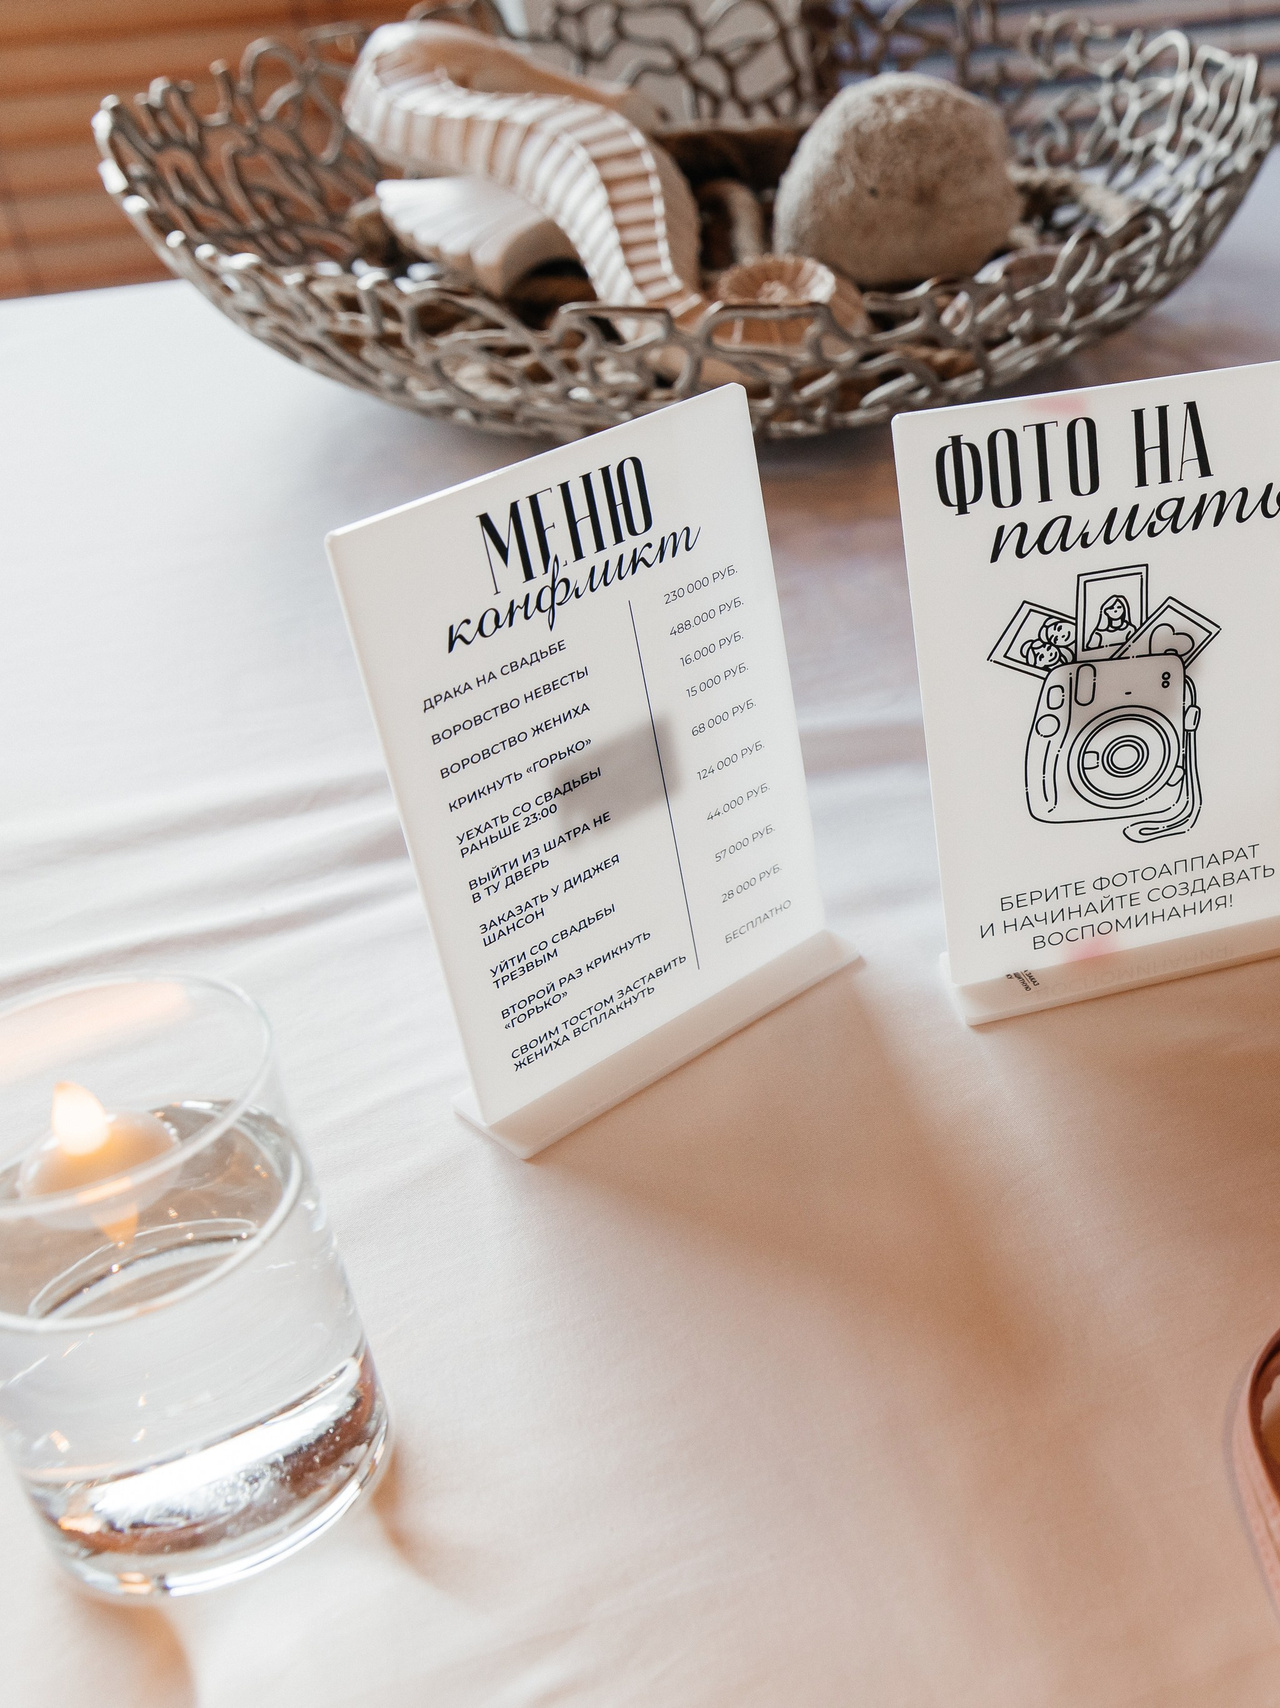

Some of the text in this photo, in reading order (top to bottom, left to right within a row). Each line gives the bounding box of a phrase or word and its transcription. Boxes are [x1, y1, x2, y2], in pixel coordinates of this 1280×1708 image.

[935, 400, 1214, 516] ФОТО НА
[476, 456, 653, 595] МЕНЮ
[447, 525, 702, 654] конфликт
[664, 564, 738, 605] 230 000 РУБ.
[669, 597, 744, 636] 488.000 РУБ.
[423, 640, 566, 713] ДРАКА НА СВАДЬБЕ
[680, 631, 744, 667] 16.000 РУБ.
[686, 662, 748, 697] 15 000 РУБ.
[431, 666, 589, 745] ВОРОВСТВО НЕВЕСТЫ
[691, 698, 756, 737] 68 000 РУБ.
[440, 703, 590, 779] ВОРОВСТВО ЖЕНИХА
[697, 740, 765, 780] 124 000 РУБ.
[449, 738, 591, 812] КРИКНУТЬ «ГОРЬКО»
[456, 767, 601, 845] УЕХАТЬ СО СВАДЬБЫ
[706, 782, 770, 821] 44.000 РУБ.
[460, 804, 557, 858] РАНЬШЕ 23:00
[468, 811, 611, 890] ВЫЙТИ ИЗ ШАТРА НЕ
[715, 824, 775, 862] 57 000 РУБ.
[472, 858, 550, 903] В ТУ ДВЕРЬ
[479, 854, 620, 935] ЗАКАЗАТЬ У ДИДЖЕЯ
[721, 864, 782, 903] 28 000 РУБ.
[980, 864, 1275, 938] И НАЧИНАЙТЕ СОЗДАВАТЬ
[1000, 843, 1260, 911] БЕРИТЕ ФОТОАППАРАТ
[483, 908, 544, 947] ШАНСОН
[490, 904, 616, 978] УЙТИ СО СВАДЬБЫ
[724, 900, 792, 944] БЕСПЛАТНО
[1033, 893, 1233, 950] ВОСПОМИНАНИЯ!
[493, 949, 558, 989] ТРЕЗВЫМ
[501, 931, 651, 1019] ВТОРОЙ РАЗ КРИКНУТЬ
[504, 991, 567, 1030] «ГОРЬКО»
[511, 954, 686, 1059] СВОИМ ТОСТОМ ЗАСТАВИТЬ
[514, 986, 655, 1072] ЖЕНИХА ВСПЛАКНУТЬ
